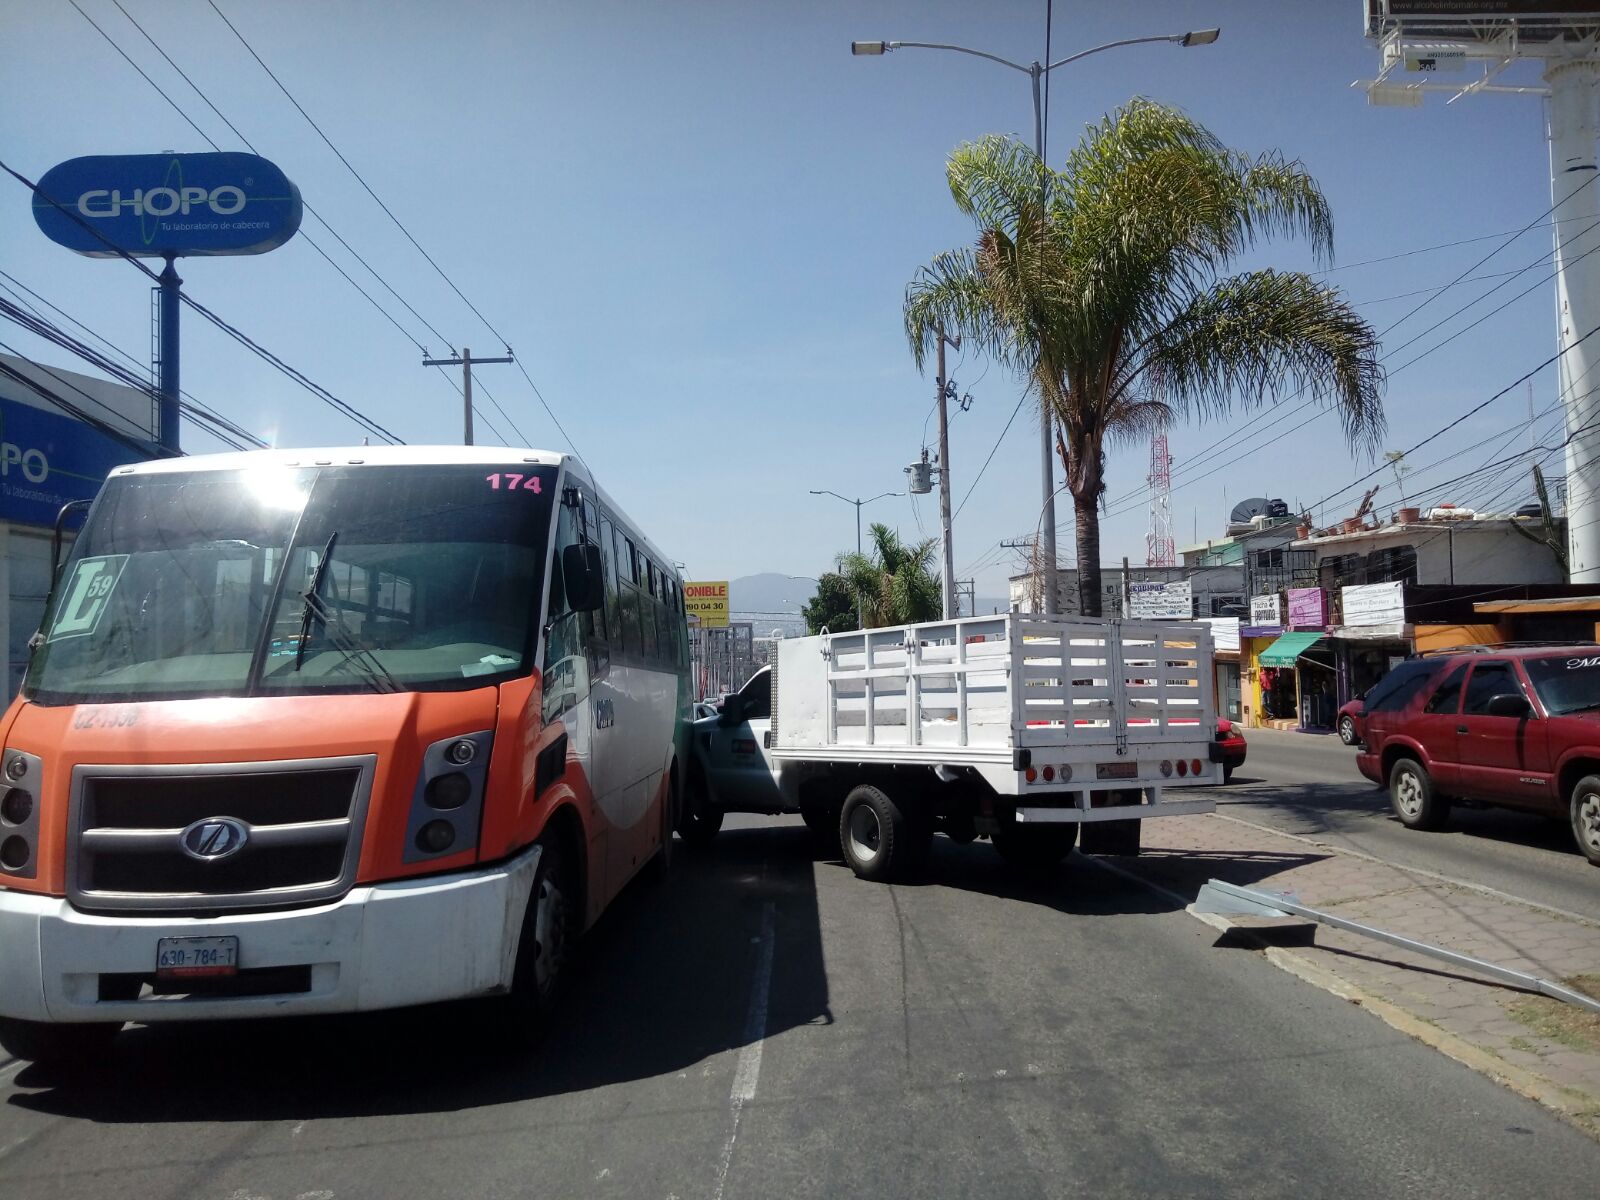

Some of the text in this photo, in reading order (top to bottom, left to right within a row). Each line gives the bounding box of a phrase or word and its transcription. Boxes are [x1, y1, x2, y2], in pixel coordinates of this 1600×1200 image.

[77, 185, 246, 218] CHOPO
[161, 221, 270, 232] Tu laboratorio de cabecera
[0, 441, 49, 483] PO
[486, 473, 543, 495] 174
[87, 575, 114, 598] 59
[701, 602, 712, 610] 04
[713, 602, 724, 610] 30
[160, 947, 234, 967] 630-784-T
